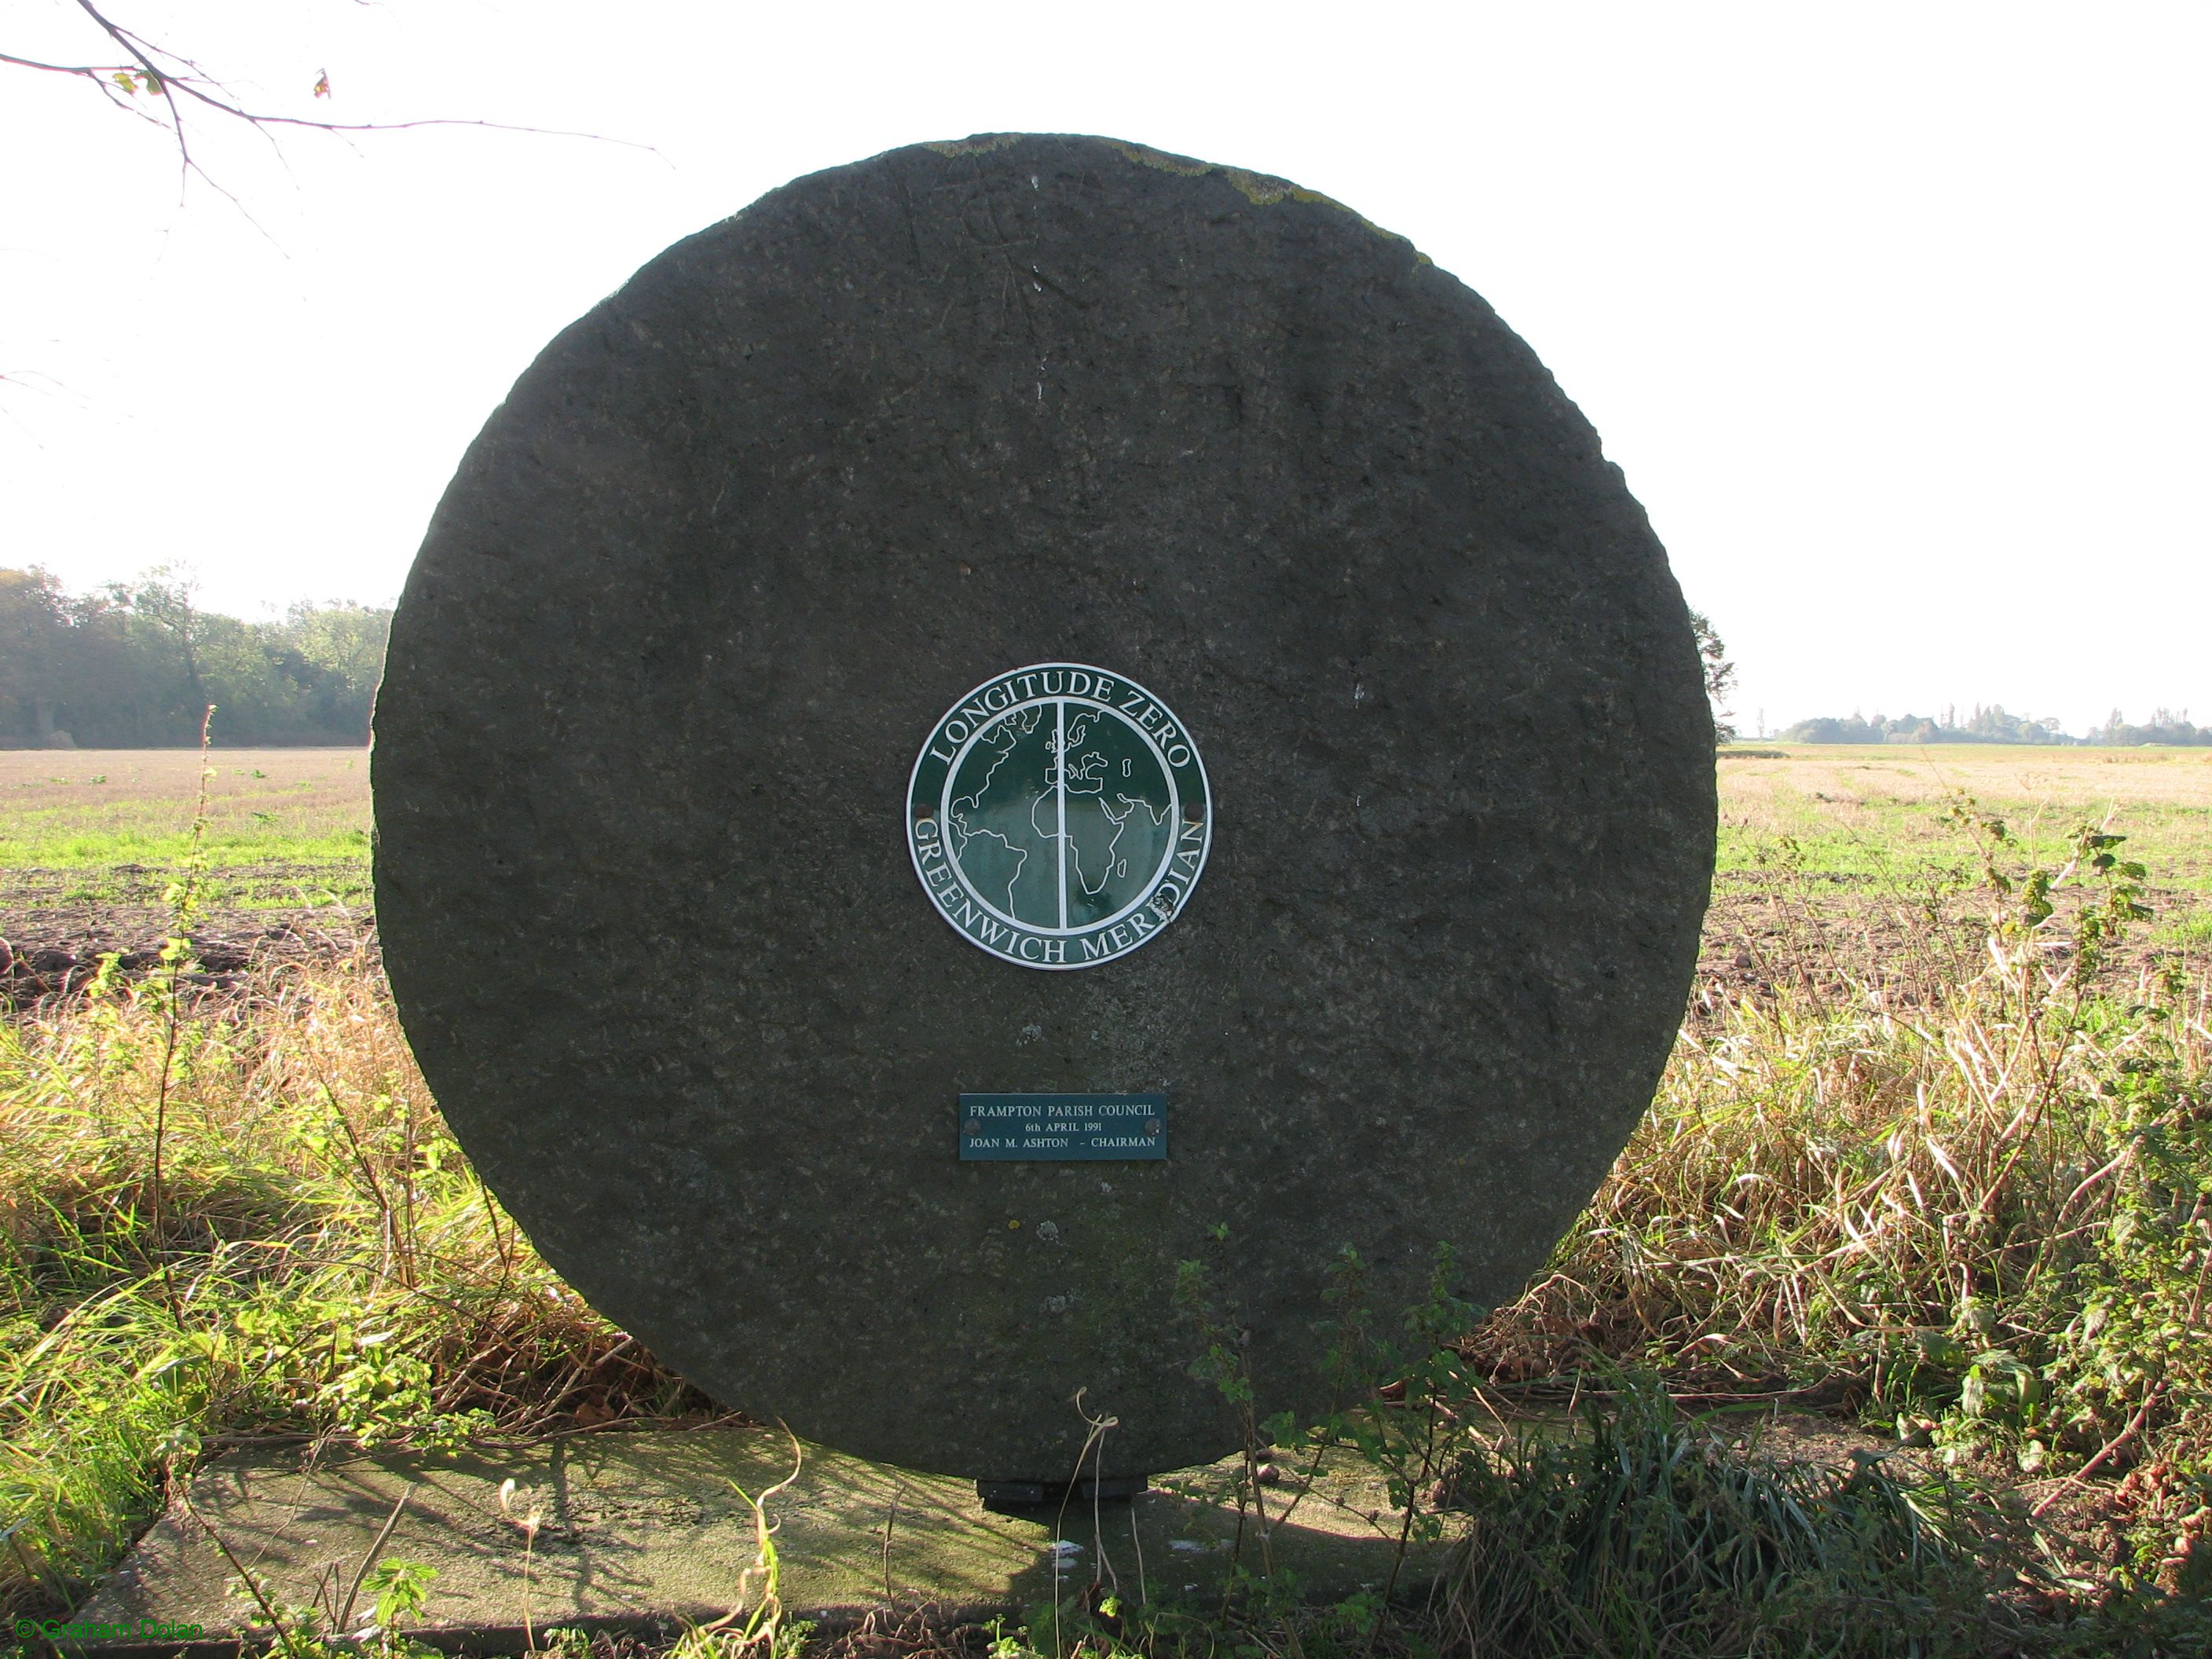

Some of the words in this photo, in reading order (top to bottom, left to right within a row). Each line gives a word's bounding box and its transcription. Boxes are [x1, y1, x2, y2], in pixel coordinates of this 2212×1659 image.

[930, 671, 1114, 766] LONGITUDE
[1119, 690, 1190, 767] ZERO
[914, 818, 1067, 963] GREENWICH
[970, 1106, 1042, 1116] FRAMPTON
[1048, 1106, 1093, 1116] PARISH
[1099, 1105, 1155, 1115] COUNCIL
[1025, 1122, 1040, 1132] 6th
[1084, 1122, 1101, 1131] 1991
[969, 1138, 1000, 1148] JOAN
[1005, 1138, 1017, 1147] M.
[1023, 1138, 1068, 1147] ASHTON
[1091, 1137, 1155, 1147] CHAIRMAN
